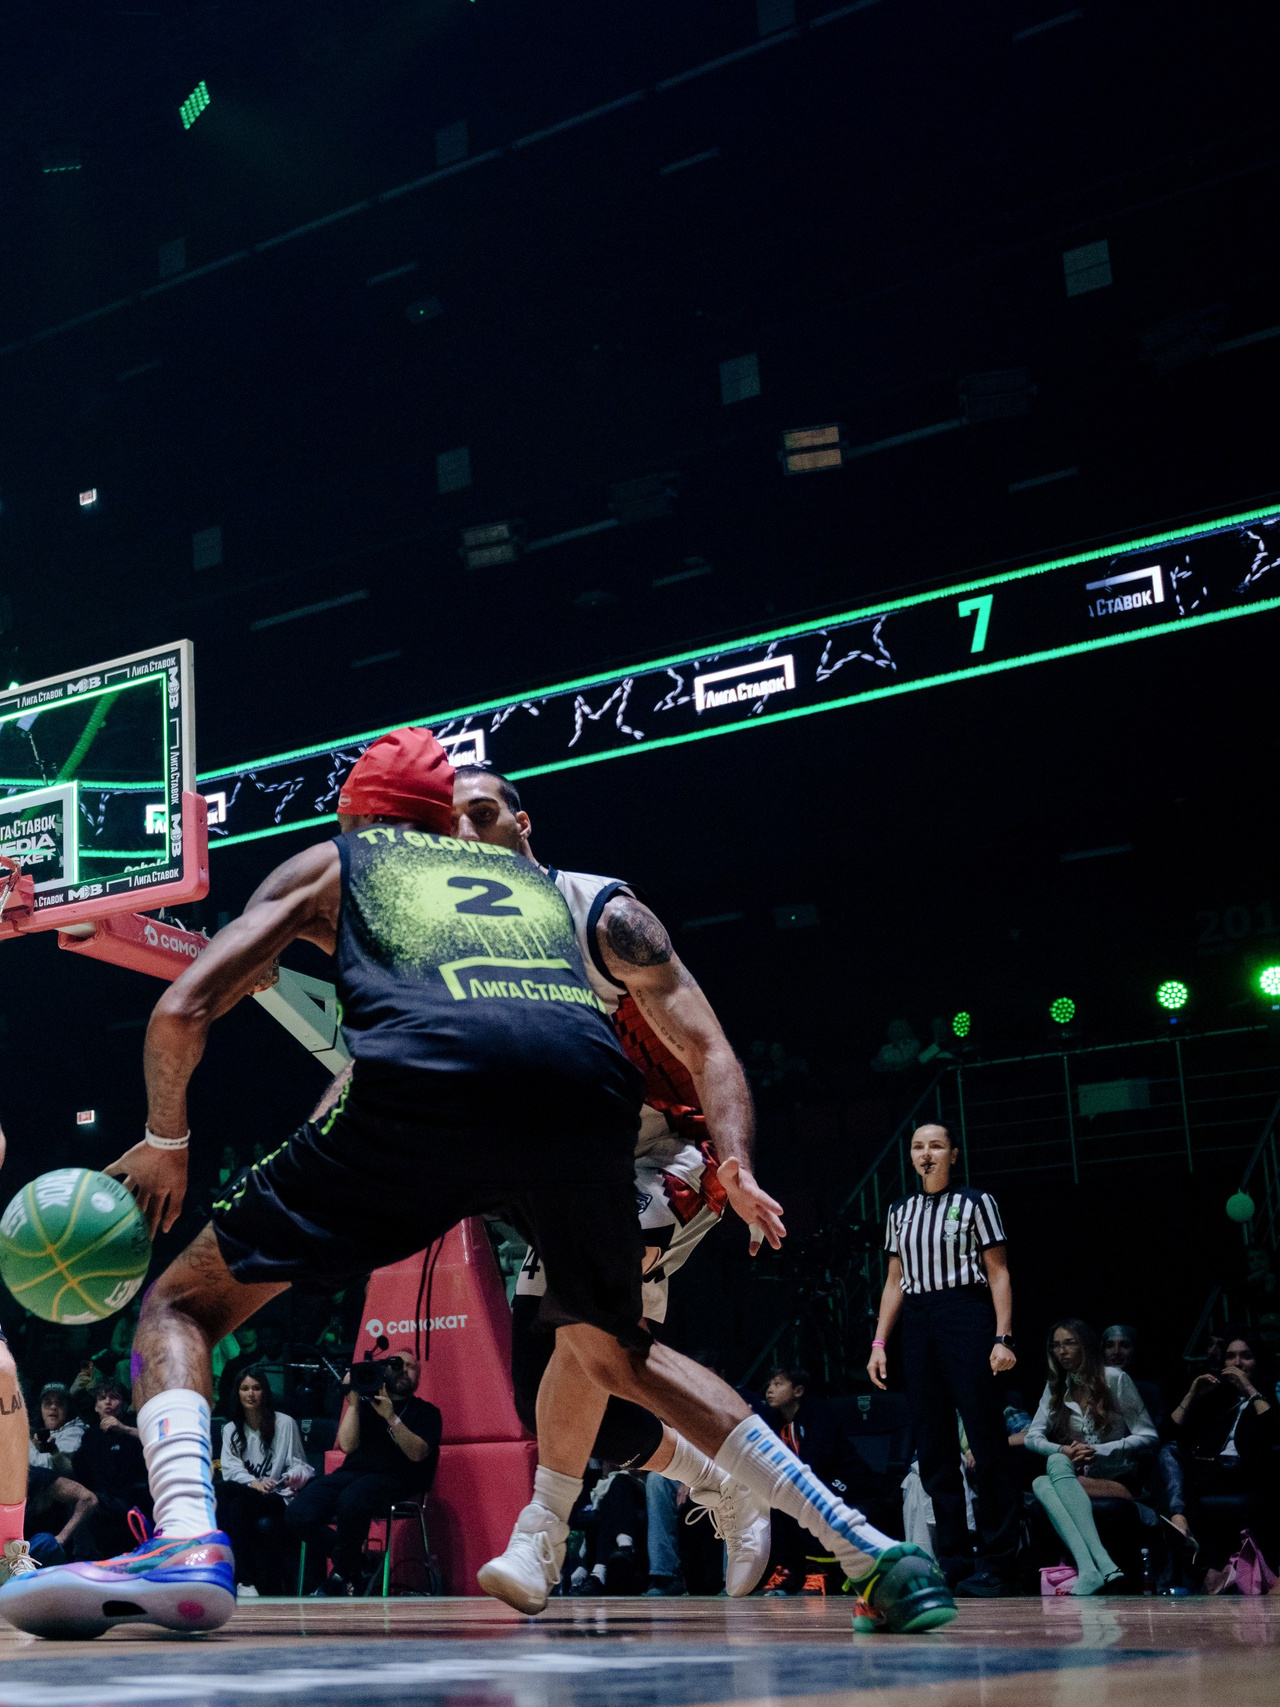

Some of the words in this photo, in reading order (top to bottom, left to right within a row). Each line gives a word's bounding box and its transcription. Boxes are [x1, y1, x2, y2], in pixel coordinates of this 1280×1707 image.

[958, 594, 993, 653] 7
[357, 827, 396, 845] TY
[403, 831, 516, 858] GLOVER
[447, 876, 523, 917] 2
[946, 1206, 961, 1221] R
[521, 1256, 541, 1280] 4
